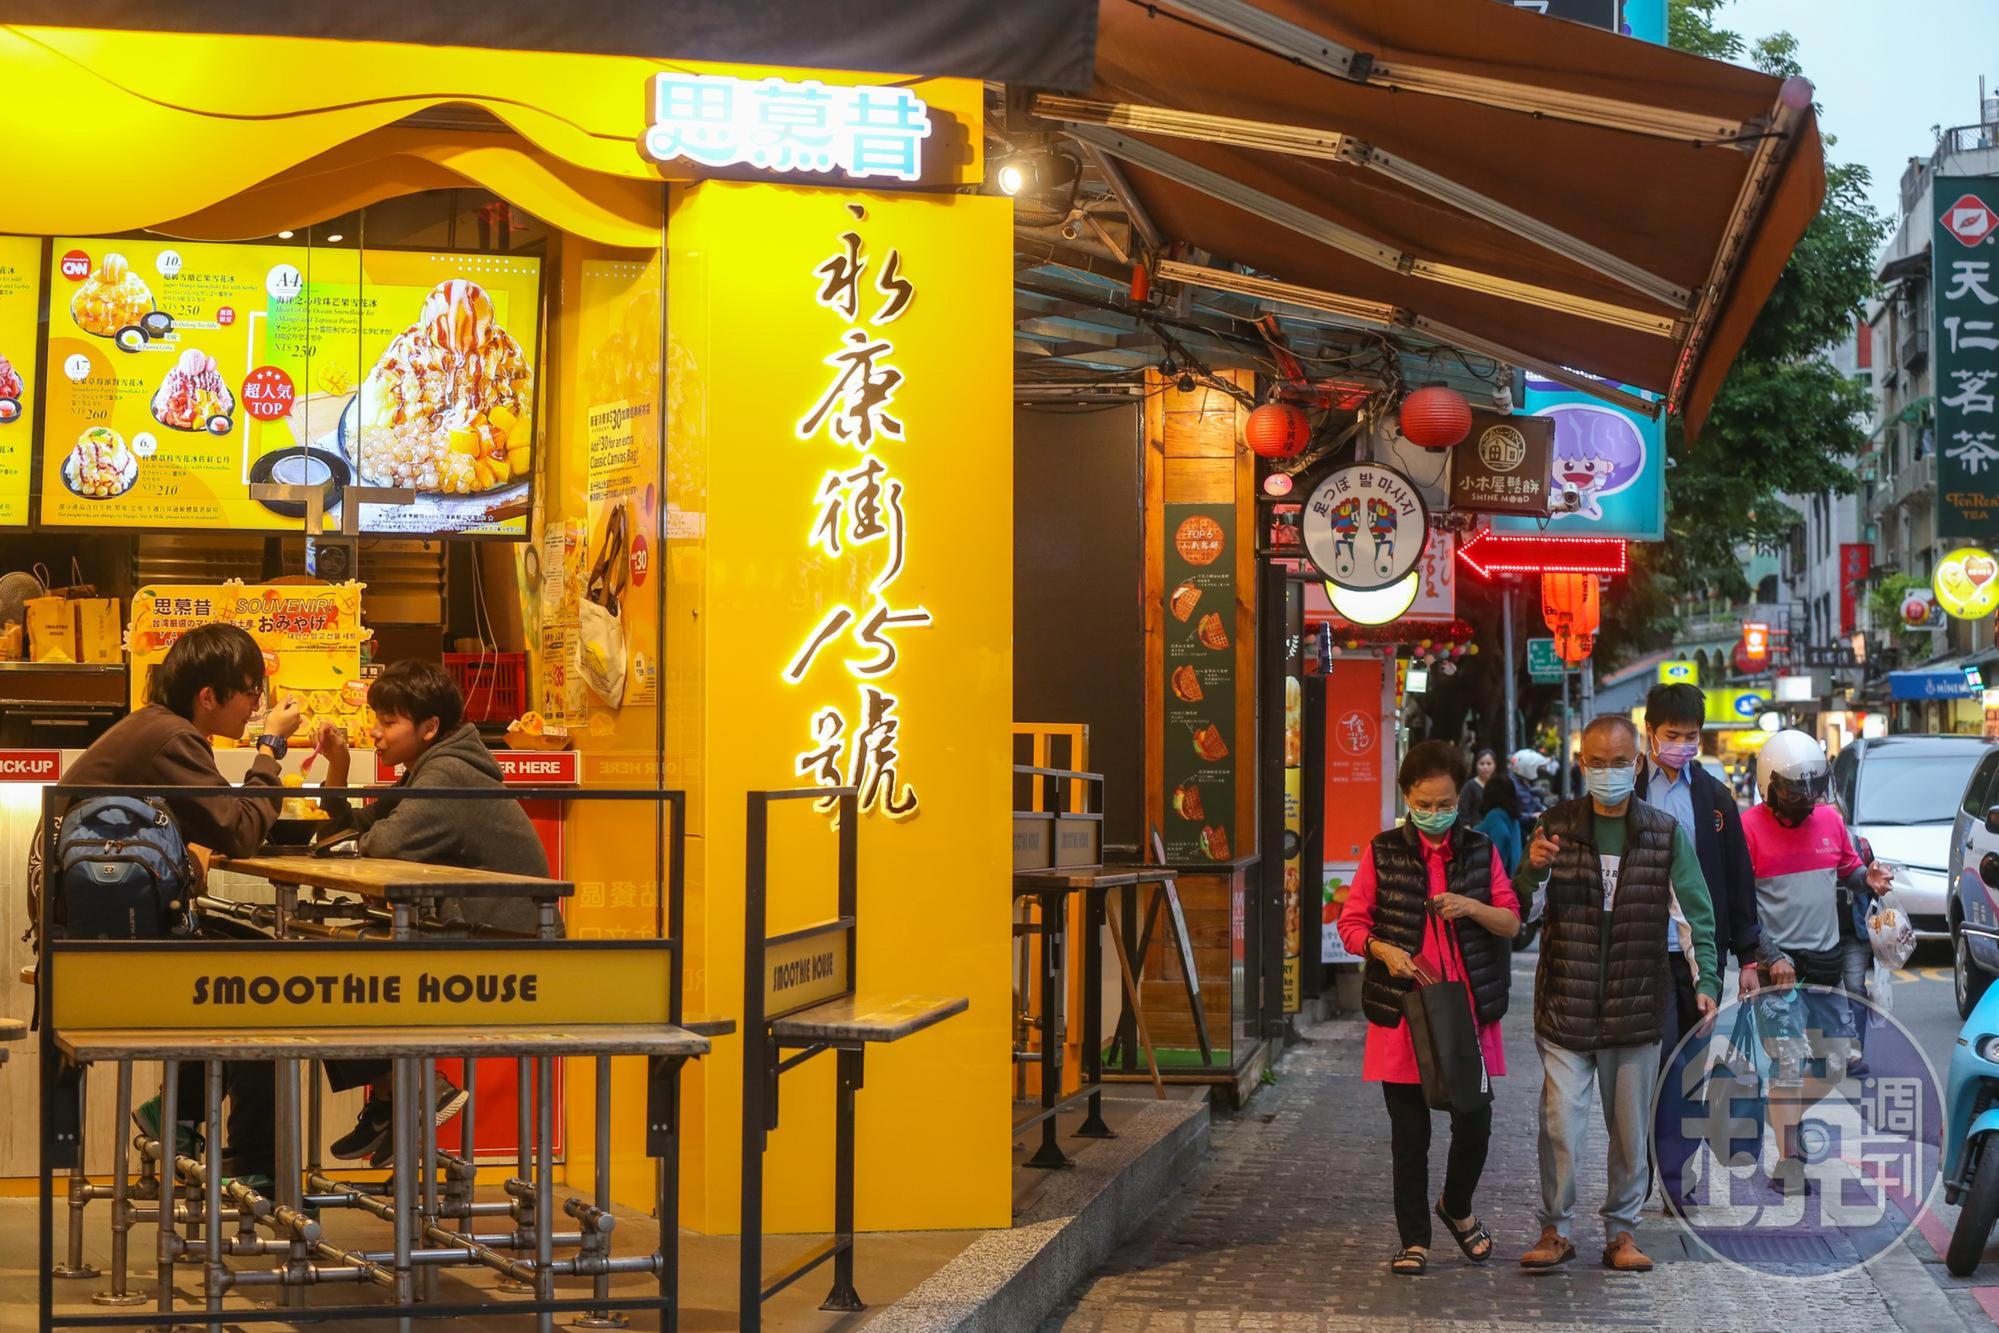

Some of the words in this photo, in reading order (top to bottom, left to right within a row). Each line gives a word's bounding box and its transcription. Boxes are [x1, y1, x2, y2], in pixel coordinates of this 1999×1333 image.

[648, 74, 930, 180] 思慕昔
[63, 261, 87, 275] CNN
[1942, 260, 1999, 476] 天仁茗茶
[244, 382, 293, 399] 超人気
[252, 402, 283, 415] TOP
[1359, 472, 1374, 487] 발
[1377, 476, 1416, 516] 마사지
[1459, 476, 1540, 495] 小木屋鬆餅
[1961, 510, 1989, 520] TEA
[154, 598, 212, 616] 思慕昔
[235, 598, 335, 614] SOUVENIR!
[258, 615, 328, 633] おみやげ
[519, 762, 561, 774] HERE
[773, 957, 811, 992] SMOOTHIE
[812, 952, 833, 981] HOUSE
[193, 973, 401, 1005] SMOOTHIE
[418, 972, 537, 1004] HOUSE
